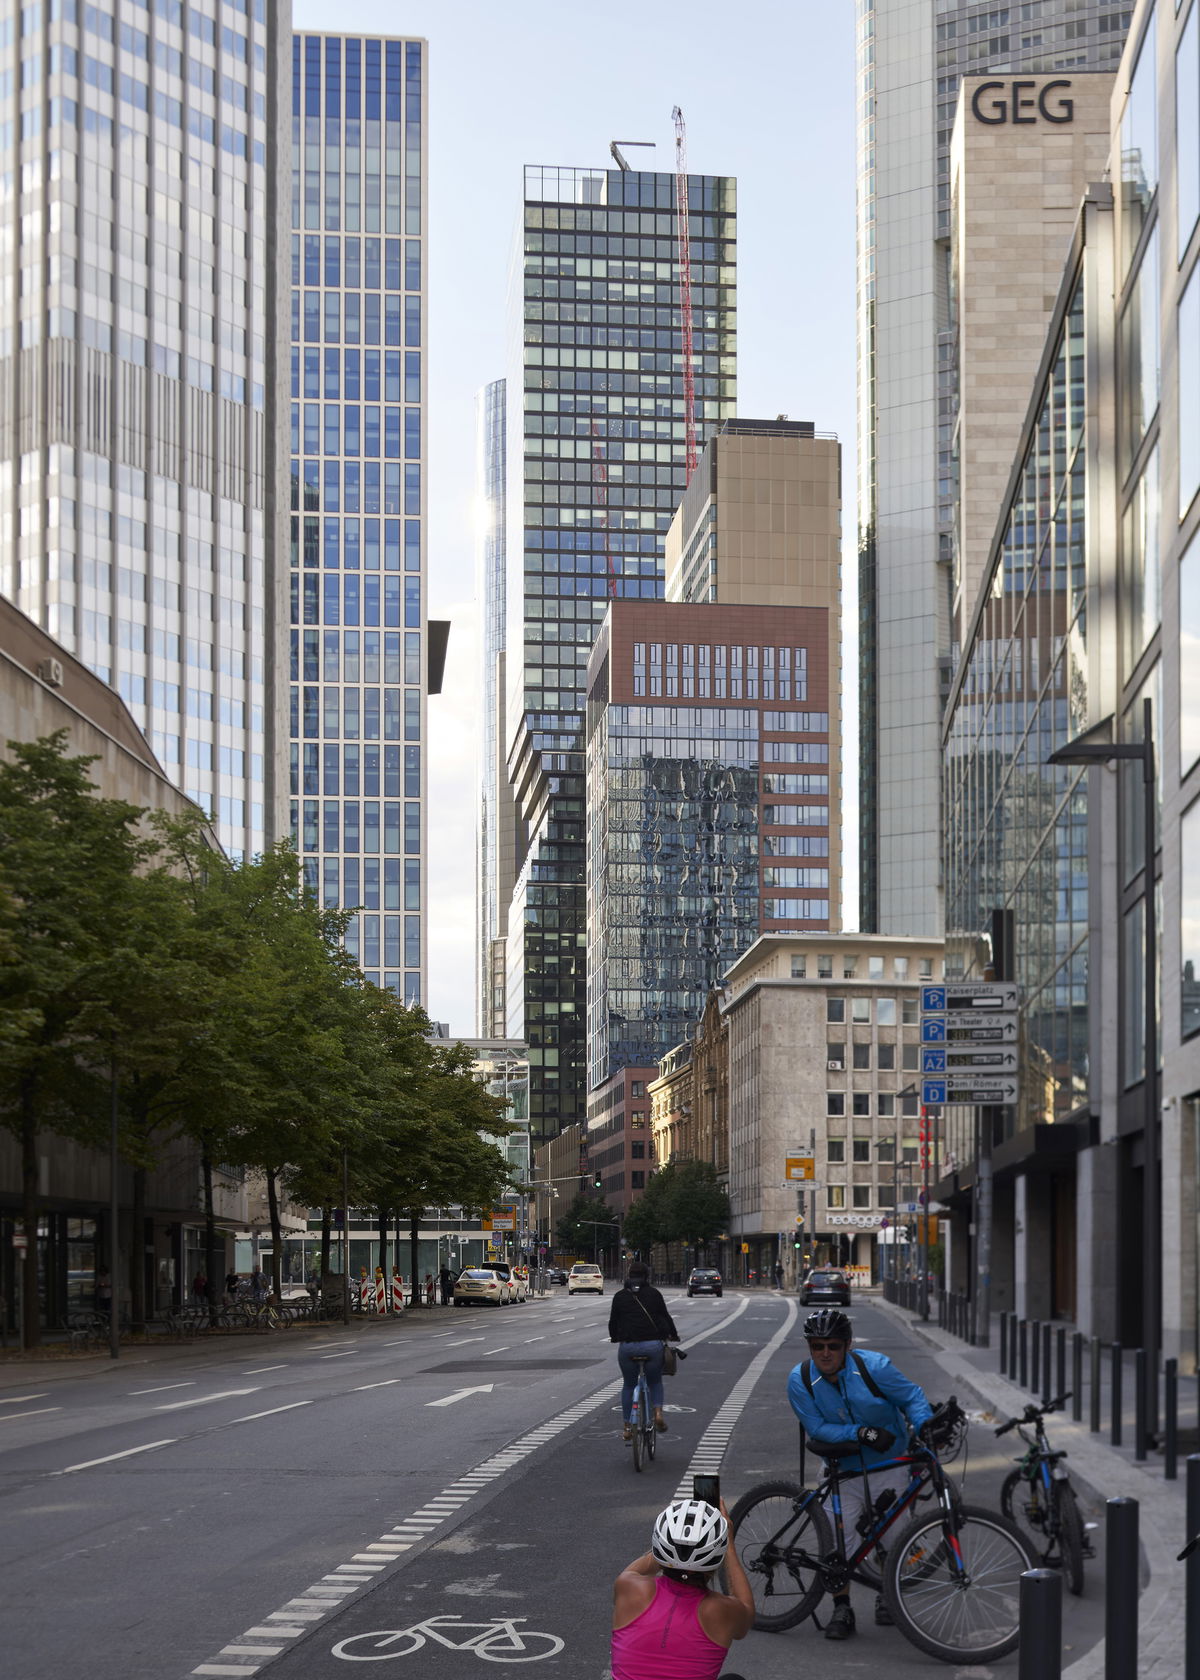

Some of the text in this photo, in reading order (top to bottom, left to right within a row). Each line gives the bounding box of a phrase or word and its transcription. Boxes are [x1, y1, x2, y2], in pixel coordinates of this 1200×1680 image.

[971, 79, 1074, 125] GEG
[947, 987, 994, 996] Kaiserplatz
[947, 1018, 983, 1026] Am Theater
[925, 1058, 944, 1071] AZ
[930, 1089, 939, 1101] D
